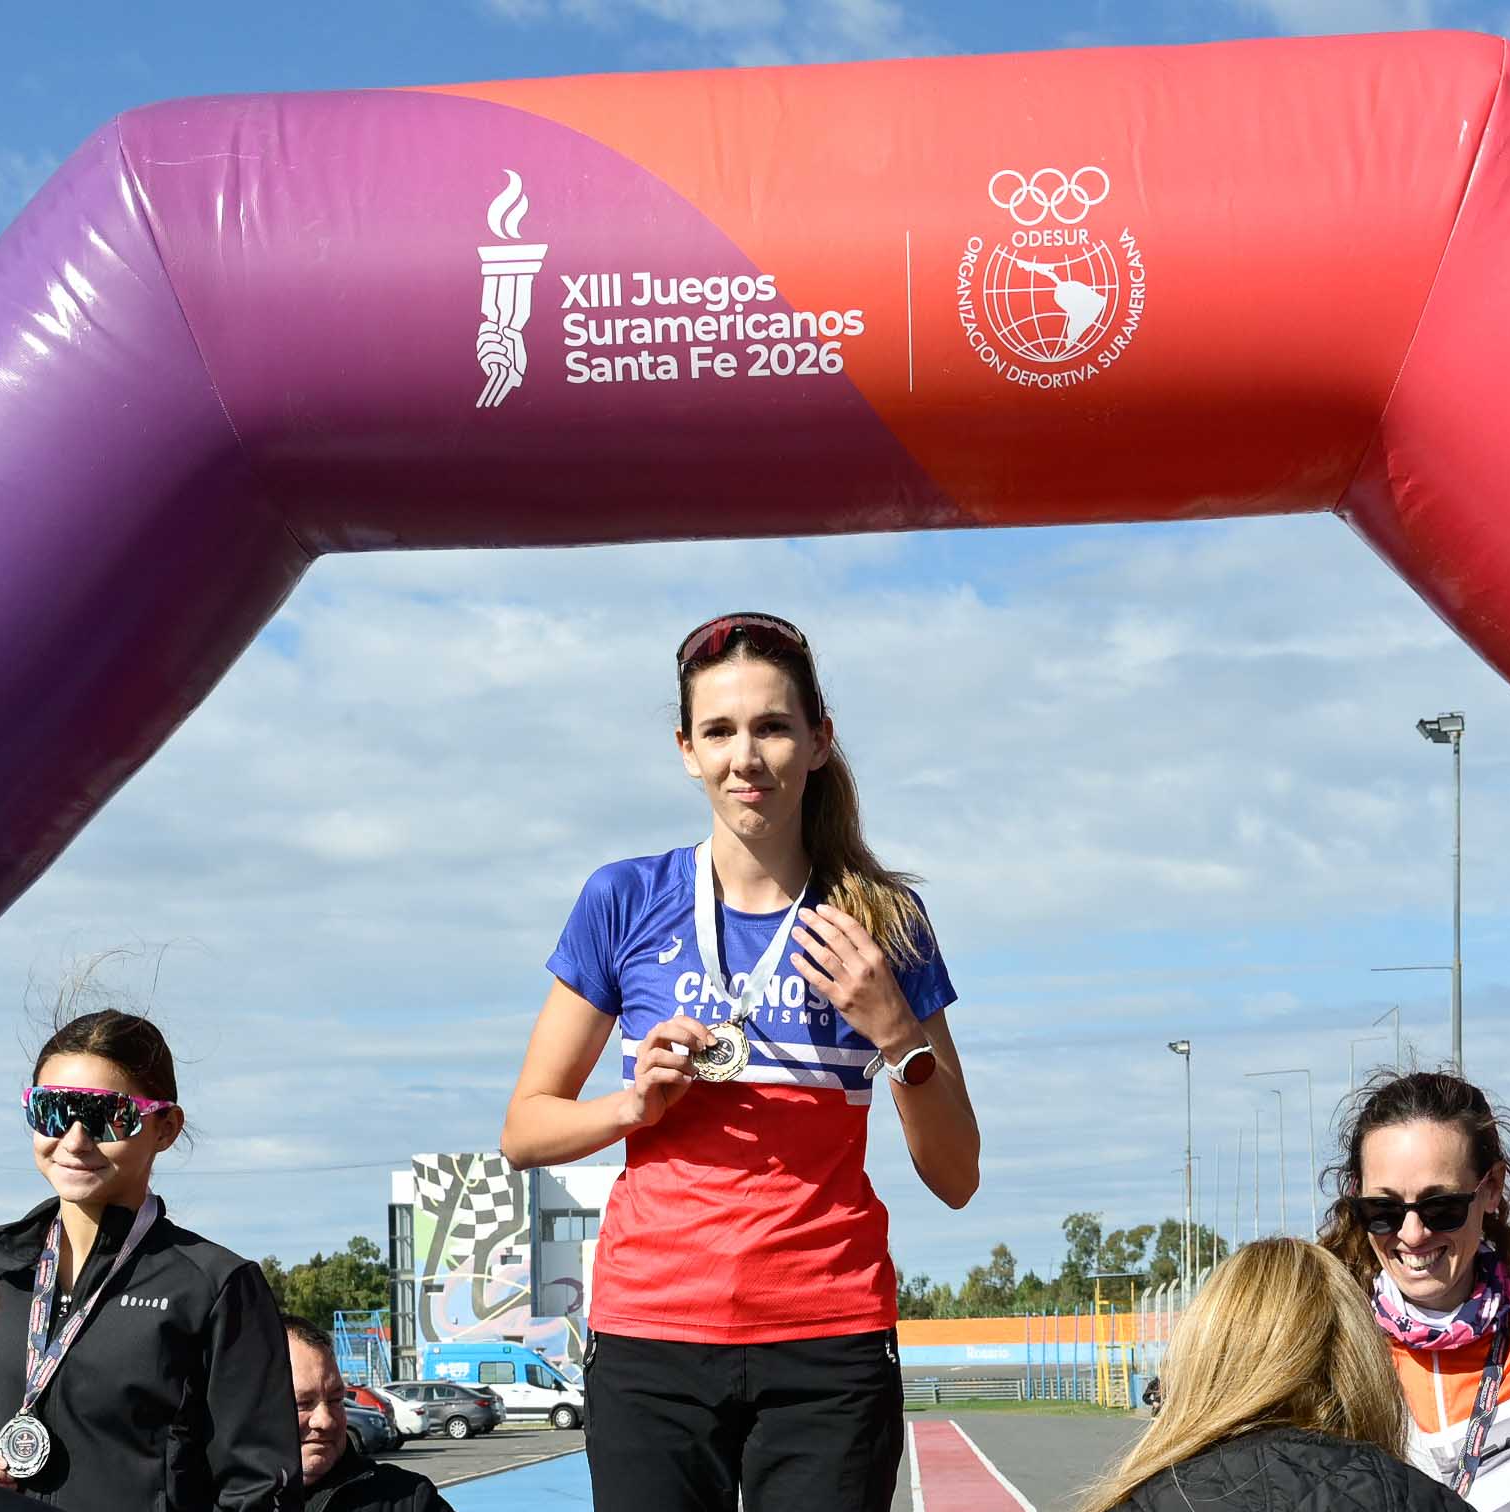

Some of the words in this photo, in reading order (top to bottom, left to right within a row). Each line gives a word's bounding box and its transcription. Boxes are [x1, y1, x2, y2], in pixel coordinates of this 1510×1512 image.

[1011, 228, 1090, 248] ODESUR
[559, 272, 622, 310] XIII
[630, 271, 778, 312] Juegos
[956, 236, 1007, 374] ORGANIZACION
[1005, 363, 1100, 389] DEPORTIVA
[1097, 226, 1146, 369] SURAMERICANA
[562, 303, 866, 348] Suramericanos
[565, 349, 679, 385] Santa
[689, 345, 739, 379] Fe
[744, 340, 844, 378] 2026
